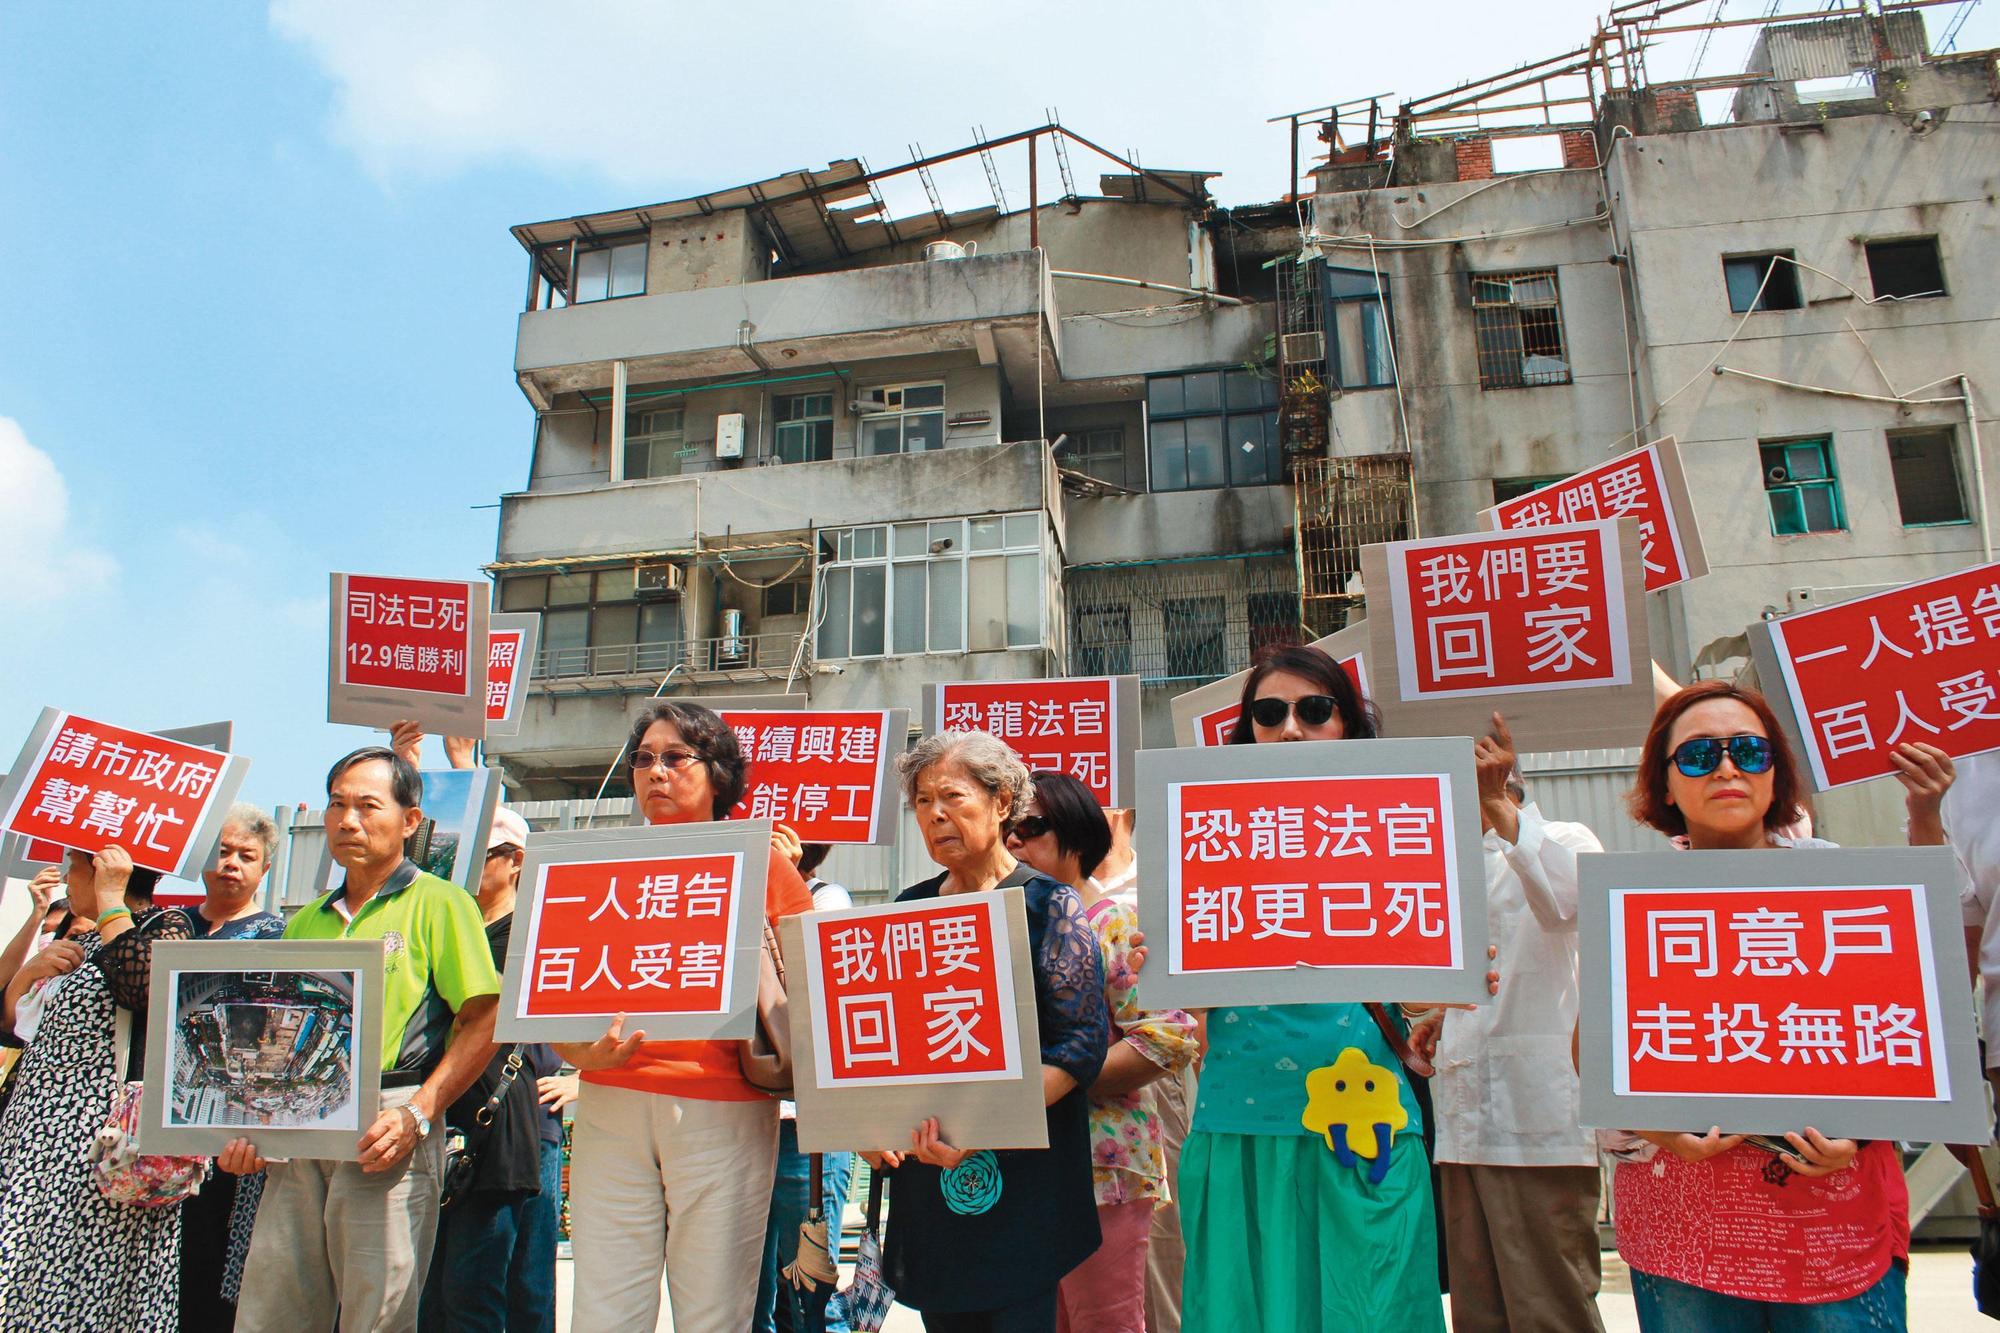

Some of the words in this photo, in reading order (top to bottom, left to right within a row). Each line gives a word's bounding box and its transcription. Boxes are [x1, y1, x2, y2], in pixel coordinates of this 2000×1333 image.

[1419, 539, 1589, 608] 我們要
[349, 591, 466, 632] 司法已死
[347, 642, 464, 676] 12.9億勝利
[489, 641, 515, 668] 照
[946, 699, 1105, 738] 恐龍法官
[1814, 669, 2000, 760] 百人受
[49, 728, 216, 799] 請市政府
[1017, 752, 1107, 789] 已死
[32, 777, 184, 853] 幫幫忙
[721, 783, 870, 822] 能停工
[1184, 802, 1435, 863] 恐龍法官
[544, 872, 728, 922] 一人提告
[1185, 881, 1445, 943] 都更已死
[537, 942, 723, 993] 百人受害
[830, 914, 980, 986] 我們要
[1647, 905, 1893, 979] 同意戶
[1632, 1002, 1923, 1067] 走投無路
